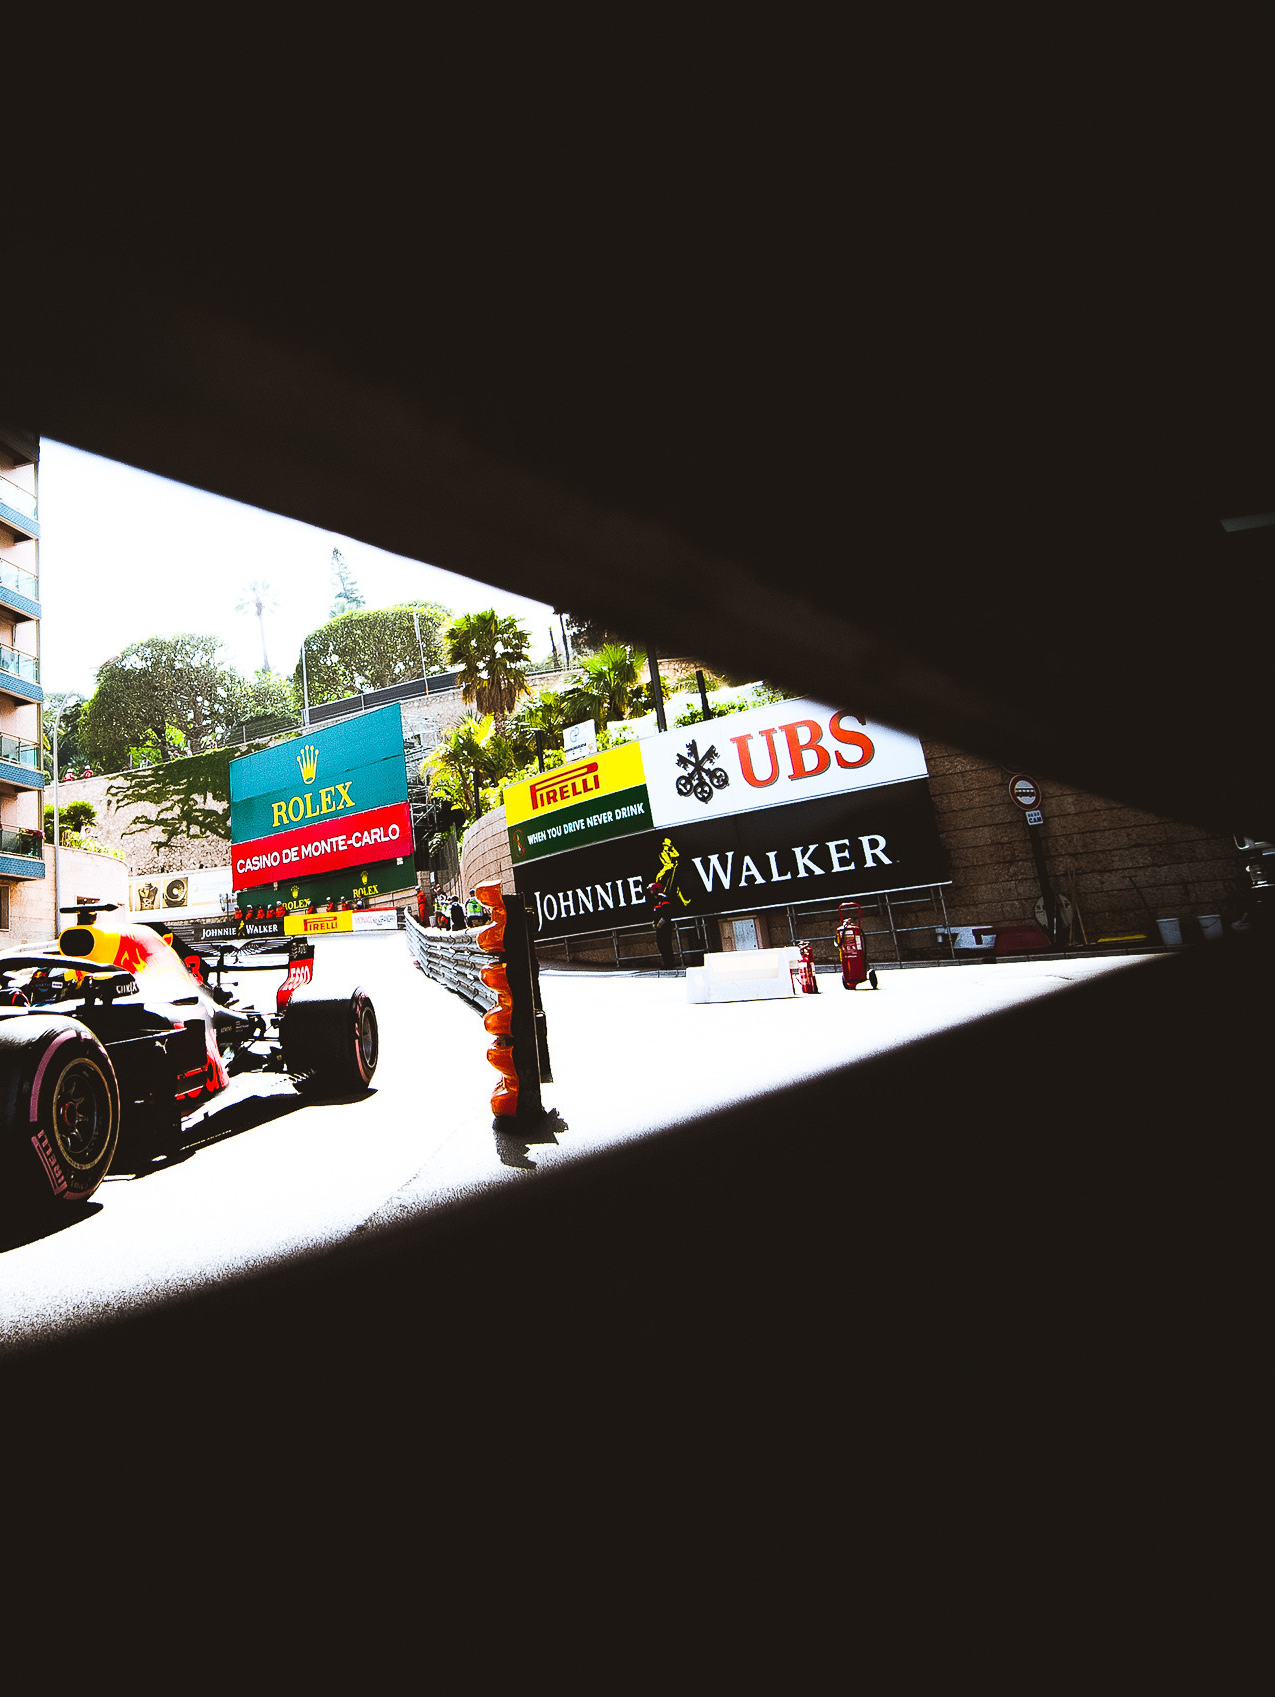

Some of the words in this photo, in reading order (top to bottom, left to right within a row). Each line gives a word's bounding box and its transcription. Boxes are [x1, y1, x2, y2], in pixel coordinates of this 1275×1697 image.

[730, 709, 875, 789] UBS
[271, 781, 356, 828] ROLEX
[529, 762, 601, 811] PIRELLI
[527, 830, 547, 846] WHEN
[546, 823, 563, 839] YOU
[563, 818, 585, 835] DRIVE
[586, 809, 614, 827] NEVER
[614, 802, 645, 820] DRINK
[236, 856, 281, 874] CASINO
[282, 846, 300, 864] DE
[301, 823, 400, 860] MONTE-CARLO
[282, 897, 311, 911] ROLEX
[352, 884, 379, 899] ROLEX
[534, 875, 647, 932] JOHNNIE
[691, 834, 893, 893] WALKER
[201, 926, 237, 940] JOHNNIE
[246, 923, 279, 935] WALKER
[304, 916, 338, 932] PIRELLI
